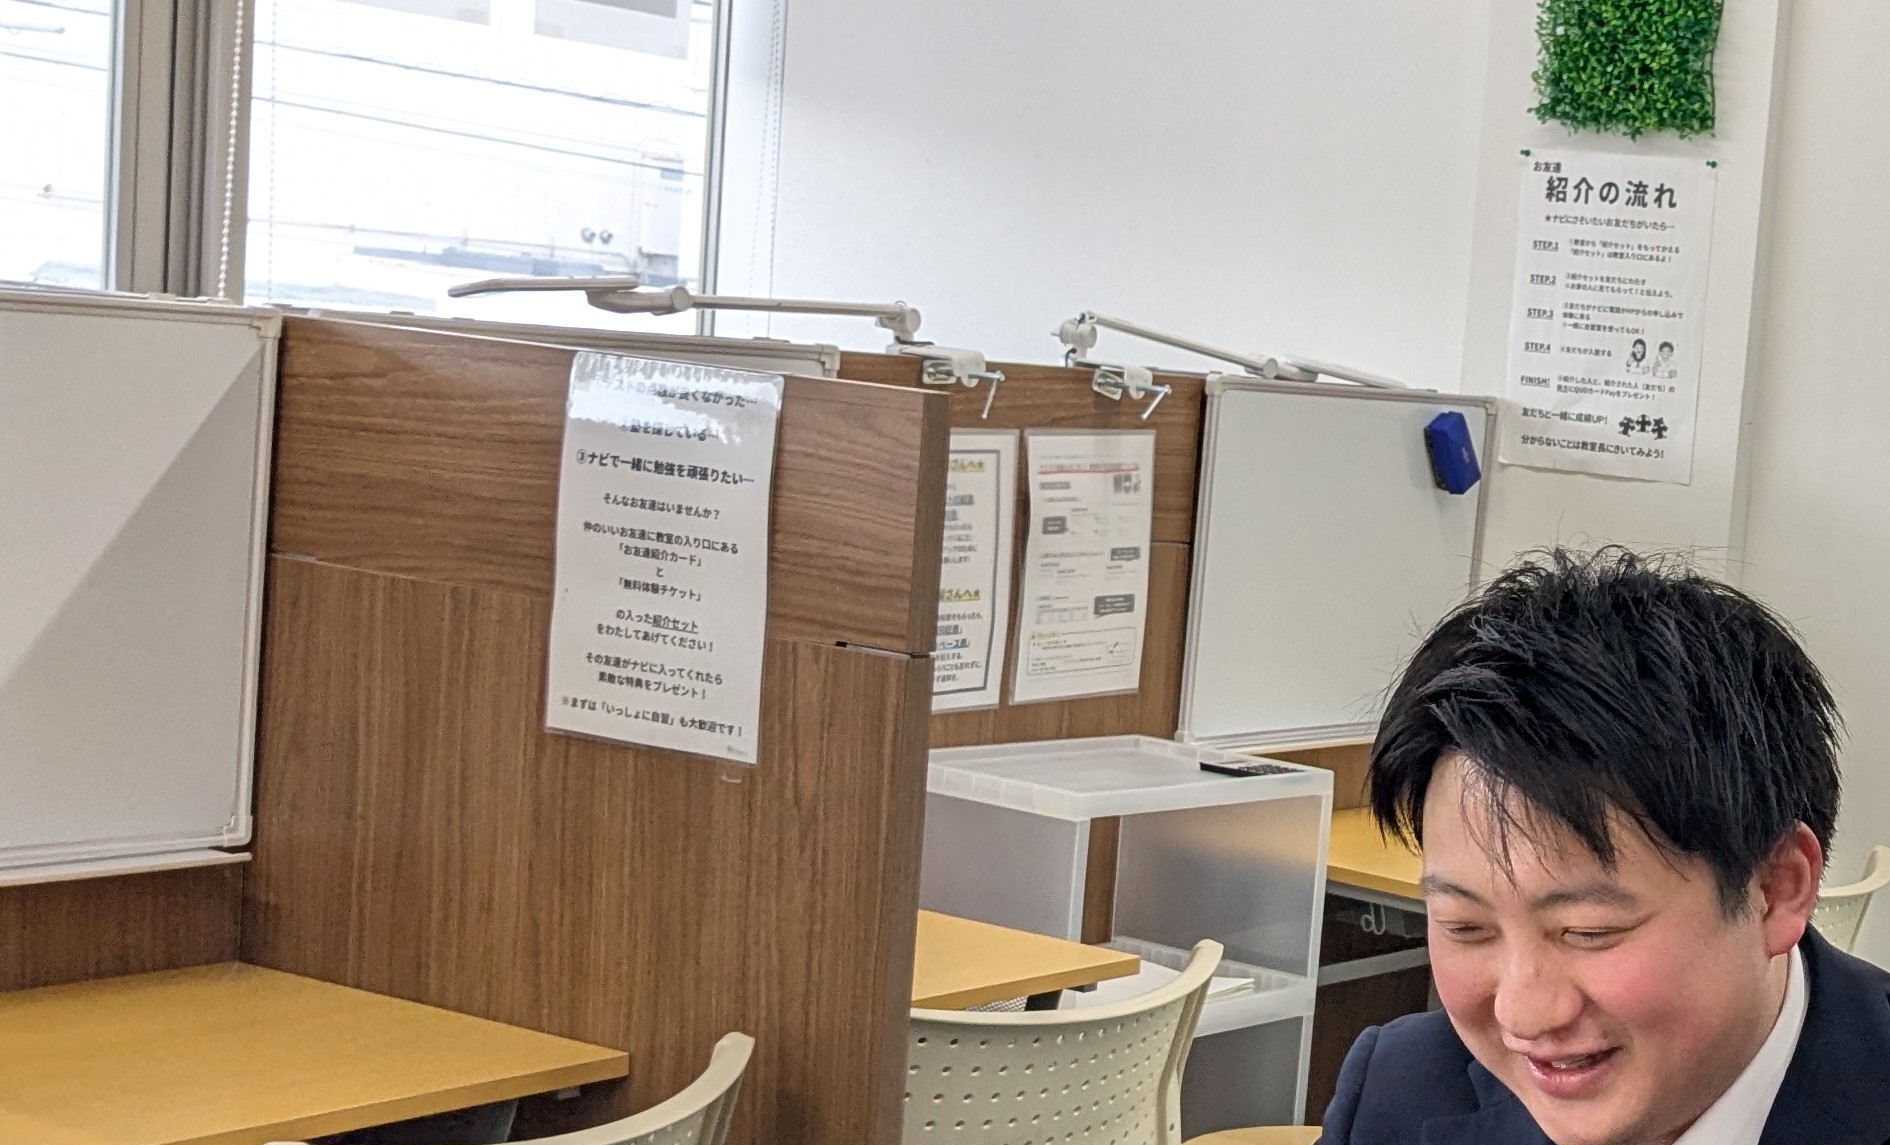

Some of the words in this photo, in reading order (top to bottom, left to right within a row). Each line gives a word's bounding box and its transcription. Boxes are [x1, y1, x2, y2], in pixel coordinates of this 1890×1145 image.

[1533, 161, 1562, 173] お友達
[1545, 175, 1677, 209] 紹介の流れ
[656, 566, 665, 577] と
